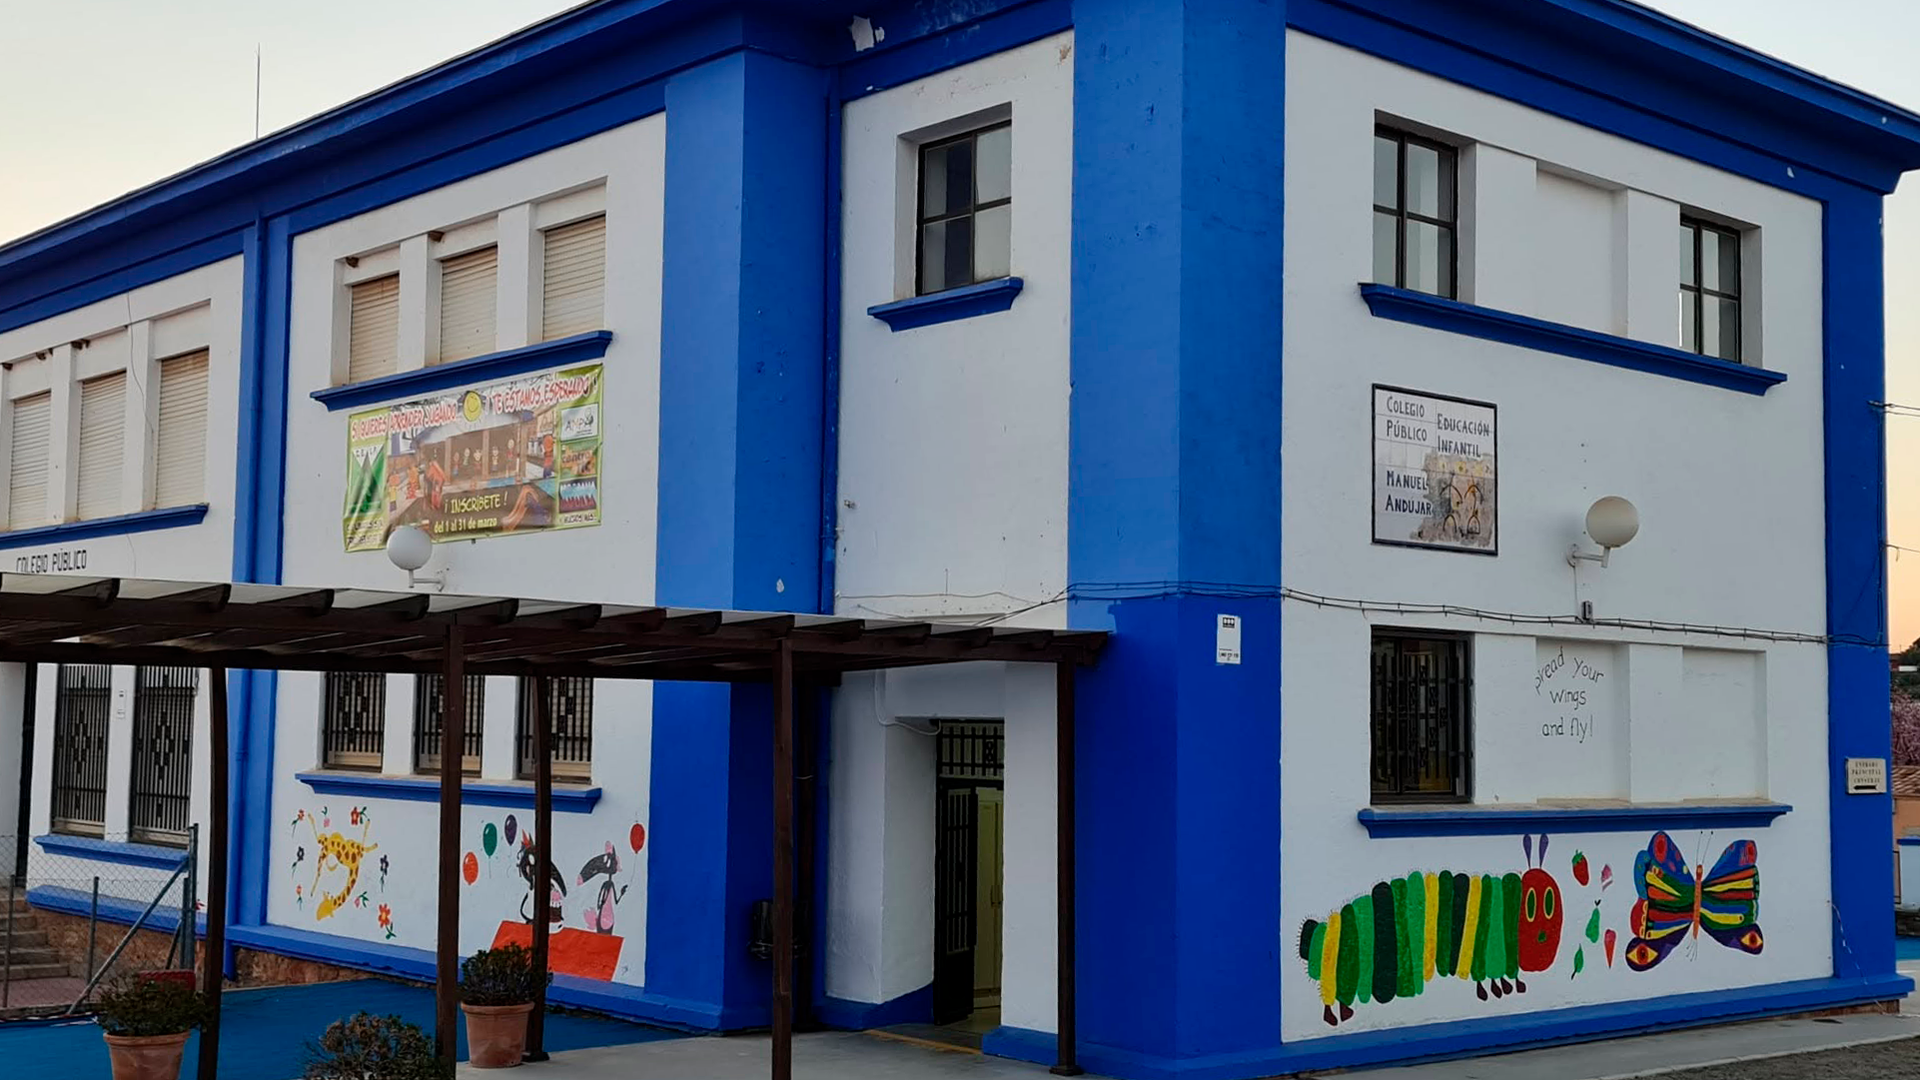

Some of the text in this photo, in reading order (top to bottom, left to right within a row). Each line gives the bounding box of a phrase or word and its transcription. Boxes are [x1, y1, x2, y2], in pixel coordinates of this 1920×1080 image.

[493, 392, 503, 413] TE
[504, 385, 541, 412] ESTAMOS
[1386, 396, 1425, 418] COLEGIO
[360, 414, 388, 437] QUIERES
[390, 409, 424, 432] APRENDER
[1386, 419, 1428, 442] PÚBLICO
[1437, 413, 1490, 437] EDUCACIÓN
[1437, 435, 1481, 458] INFANTIL
[1386, 470, 1427, 490] MANUEL
[434, 517, 498, 533] del 1 al 31 de marzo
[16, 554, 48, 573] COLEGIO
[1535, 645, 1565, 696] pread
[1549, 689, 1586, 710] wings
[1542, 717, 1564, 736] and
